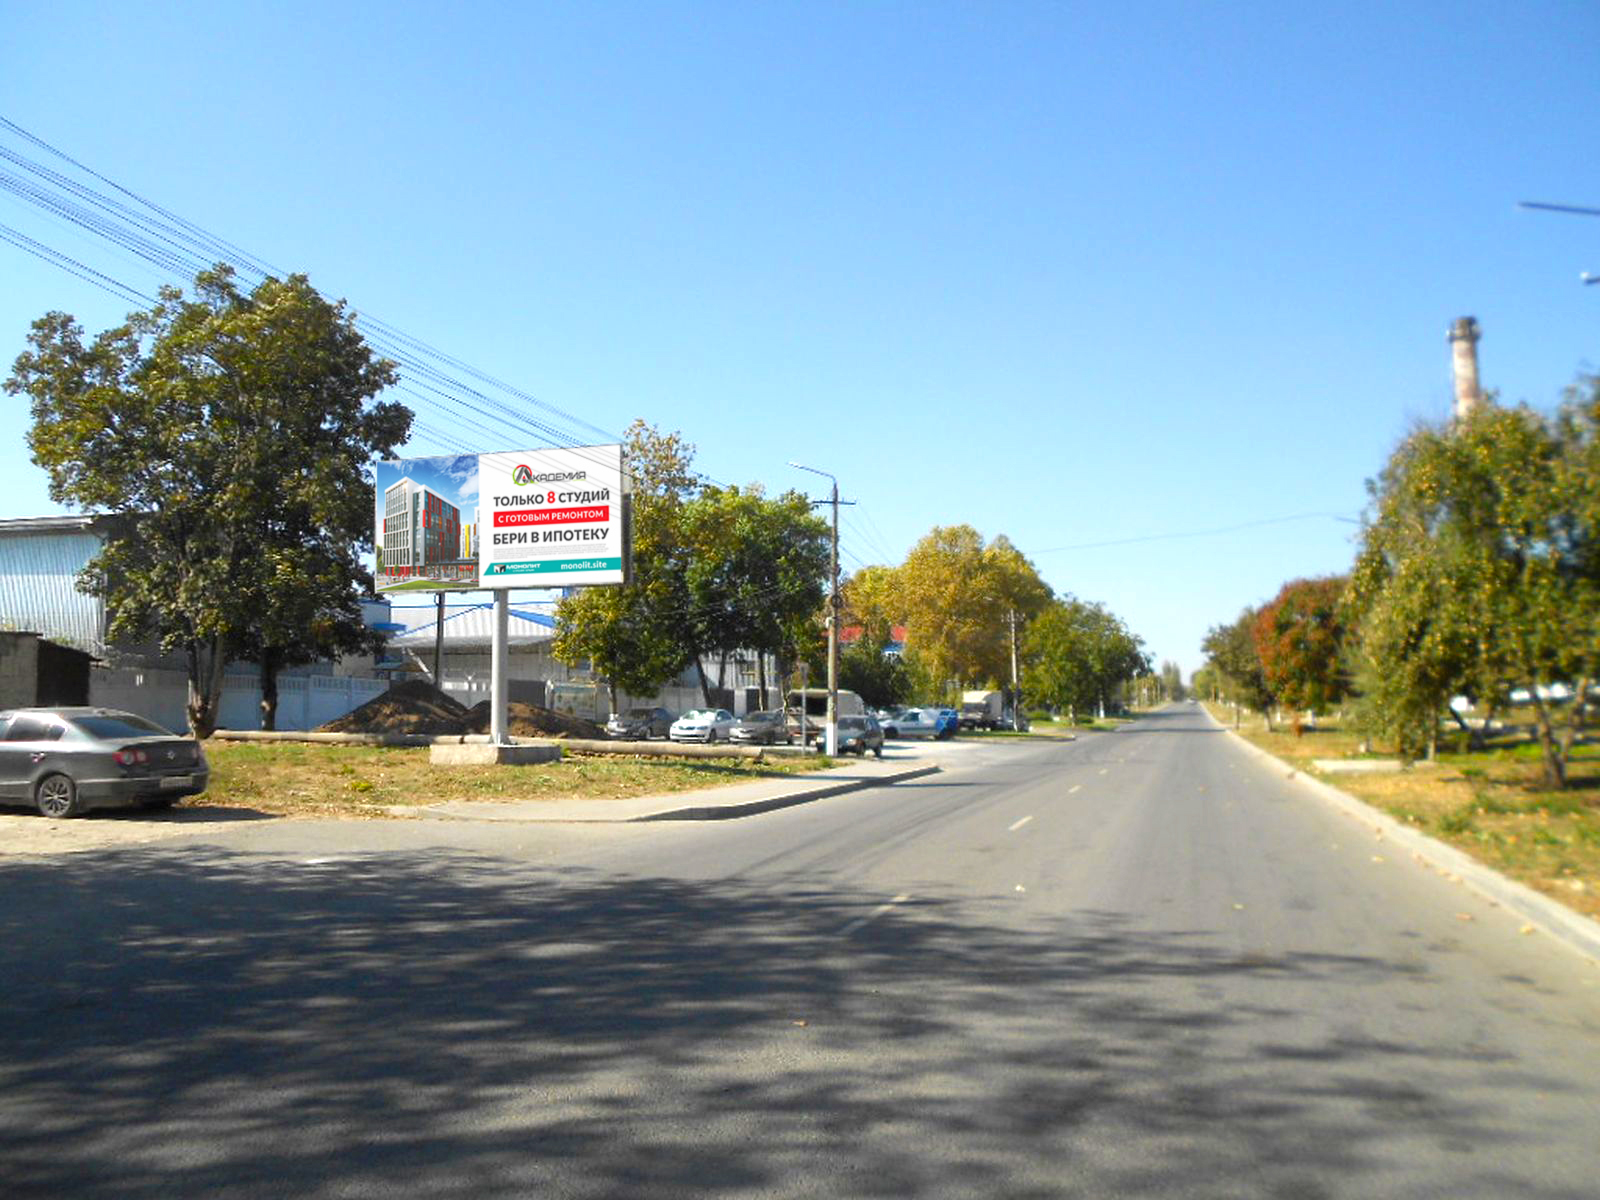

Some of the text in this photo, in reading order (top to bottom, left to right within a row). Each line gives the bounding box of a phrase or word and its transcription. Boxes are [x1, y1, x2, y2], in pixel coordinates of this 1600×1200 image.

[513, 465, 586, 486] АКАДЕМИЯ
[493, 488, 610, 507] ТОЛЬКО 8 СТУДИЙ
[505, 513, 550, 523] ГОТОВЫМ
[552, 510, 604, 520] РЕМОНТОМ
[493, 528, 609, 545] БЕРИ В ИПОТЕКУ
[561, 560, 607, 570] monolit.site
